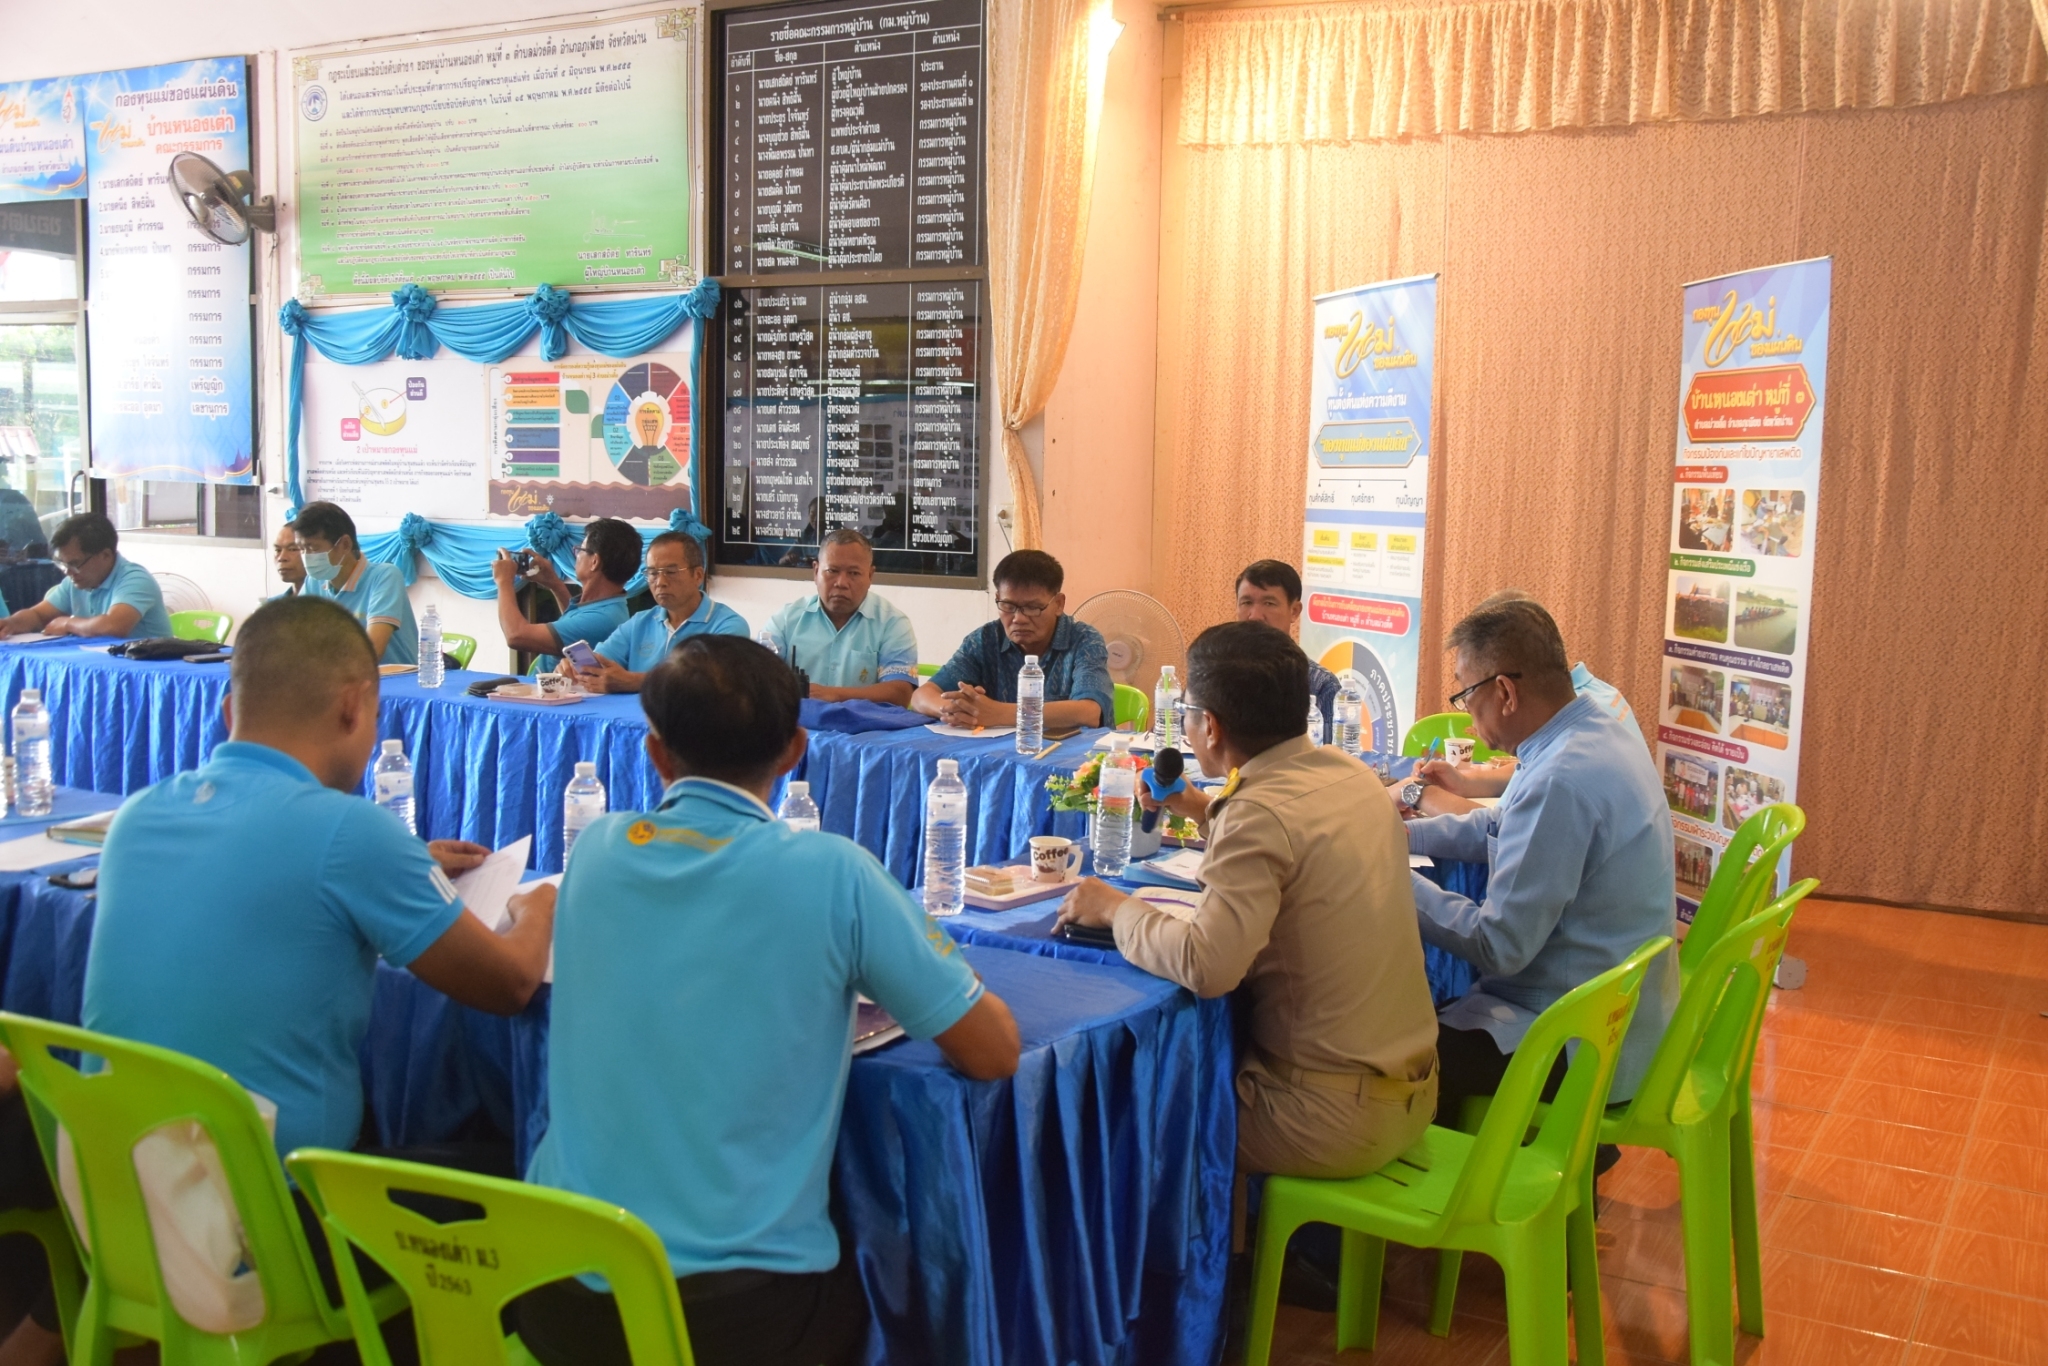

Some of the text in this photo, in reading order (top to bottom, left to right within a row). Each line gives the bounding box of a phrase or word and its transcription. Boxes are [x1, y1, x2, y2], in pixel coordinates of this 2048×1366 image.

[771, 11, 930, 42] รายชื่อคณะกรรมการหมู่บ้าน (กม.หมู่บ้าน)
[854, 40, 881, 53] ตำแหน่ง
[932, 32, 961, 45] ตำแหน่ง
[487, 43, 503, 68] หมู่ที่
[608, 29, 647, 49] จังหวัดน่าน
[774, 48, 798, 63] ชื่อ-สกุล
[921, 61, 944, 73] ประธาน
[832, 66, 862, 86] ผู้ใหญ่บ้าน
[920, 74, 968, 92] รองประธานคนที่
[115, 80, 237, 111] กองทุนแม่ของแผ่นดิน
[920, 93, 968, 111] รองประธานคนที่
[831, 102, 865, 123] ผู้ทรงคุณวุฒิ
[146, 109, 235, 135] บ้านหนองเต่า
[830, 121, 880, 138] แพทย์ประจำตำบล
[919, 113, 967, 133] กรรมการหมู่บ้าน
[155, 138, 223, 155] คณะกรรมการ
[919, 133, 967, 151] กรรมการหมู่บ้าน
[918, 153, 966, 171] กรรมการหมู่บ้าน
[917, 173, 965, 190] กรรมการหมู่บ้าน
[917, 191, 965, 208] กรรมการหมู่บ้าน
[916, 211, 965, 228] กรรมการหมู่บ้าน
[916, 229, 964, 247] กรรมการหมู่บ้าน
[187, 242, 222, 253] กรรมการ
[915, 248, 964, 266] กรรมการหมู่บ้าน
[187, 266, 221, 276] กรรมการ
[584, 265, 645, 281] ผู้ใหญ่บ้านหนองเต่า
[187, 289, 221, 299] กรรมการ
[917, 288, 964, 305] กรรมการหมู่บ้าน
[188, 312, 222, 322] กรรมการ
[916, 307, 964, 324] กรรมการหมู่บ้าน
[189, 335, 223, 345] กรรมการ
[916, 325, 964, 344] กรรมการหมู่บ้าน
[915, 345, 963, 362] กรรมการหมู่บ้าน
[189, 358, 223, 368] กรรมการ
[915, 364, 963, 382] กรรมการหมู่บ้าน
[190, 378, 224, 394] เหรัญญิก
[915, 384, 962, 401] กรรมการหมู่บ้าน
[1691, 383, 1763, 410] บ้านหนองเต่า
[1764, 374, 1792, 414] หมู่ที่
[191, 403, 228, 419] เลขานุการ
[914, 401, 961, 420] กรรมการหมู่บ้าน
[914, 420, 961, 439] กรรมการหมู่บ้าน
[914, 439, 961, 455] กรรมการหมู่บ้าน
[913, 454, 960, 473] กรรมการหมู่บ้าน
